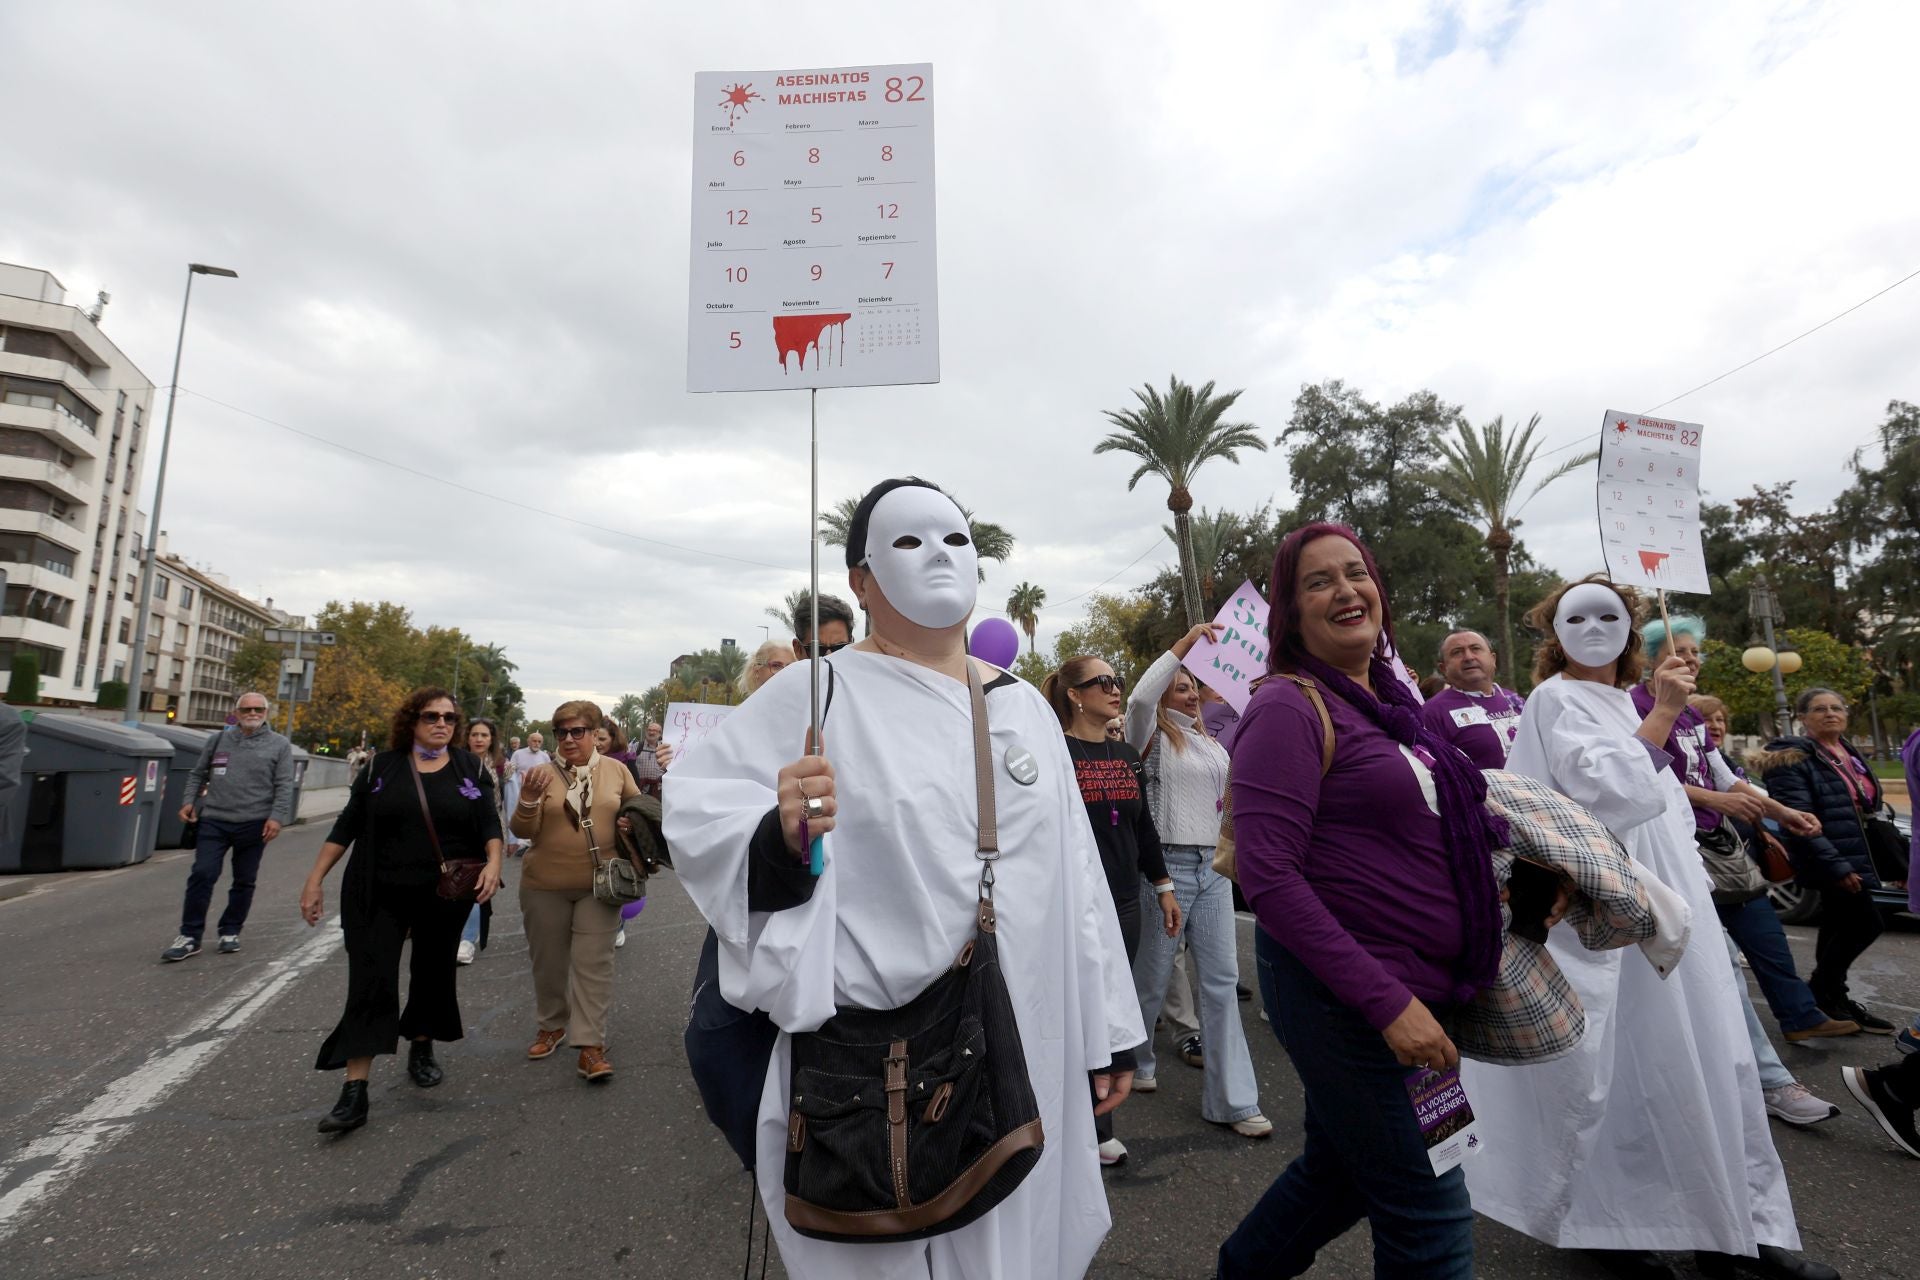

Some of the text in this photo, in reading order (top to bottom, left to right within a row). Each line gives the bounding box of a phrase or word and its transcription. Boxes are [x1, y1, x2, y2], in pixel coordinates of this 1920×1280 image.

[775, 71, 870, 87] ASESINATOS
[884, 75, 926, 103] 82
[778, 89, 867, 105] MACHISTAS
[711, 124, 731, 132] Enero
[733, 150, 745, 167] 6
[808, 147, 820, 164] 8
[881, 145, 893, 162] 8
[783, 179, 802, 188] Mayo
[857, 175, 875, 183] Junio
[810, 206, 823, 224] 5
[877, 203, 899, 219] 12
[726, 209, 749, 225] 12
[783, 239, 806, 248] Agosto
[857, 234, 897, 243] Septiembre
[706, 241, 723, 249] Julio
[725, 266, 748, 283] 10
[810, 264, 823, 281] 9
[881, 262, 895, 280] 7
[782, 299, 820, 307] Noviembre
[858, 296, 893, 304] Diciembre
[729, 331, 742, 349] 5
[1637, 418, 1676, 431] ASESINATOS
[1637, 429, 1674, 441] MACHISTAS
[1680, 430, 1699, 447] 82
[1617, 457, 1624, 468] 6
[1648, 462, 1654, 473] 8
[1676, 467, 1683, 478] 8
[1612, 491, 1623, 501] 12
[1647, 496, 1653, 505] 5
[1674, 500, 1684, 509] 12
[1615, 521, 1625, 532] 10
[1649, 526, 1655, 536] 9
[1678, 530, 1684, 540] 7
[1622, 555, 1628, 565] 5
[1094, 760, 1128, 770] TENGO
[1076, 769, 1126, 780] DERECHO
[1084, 790, 1140, 803] SIN MIEDO
[1416, 1084, 1462, 1116] LA VIOLENCIA
[1419, 1094, 1466, 1126] TIENE GÉNERO
